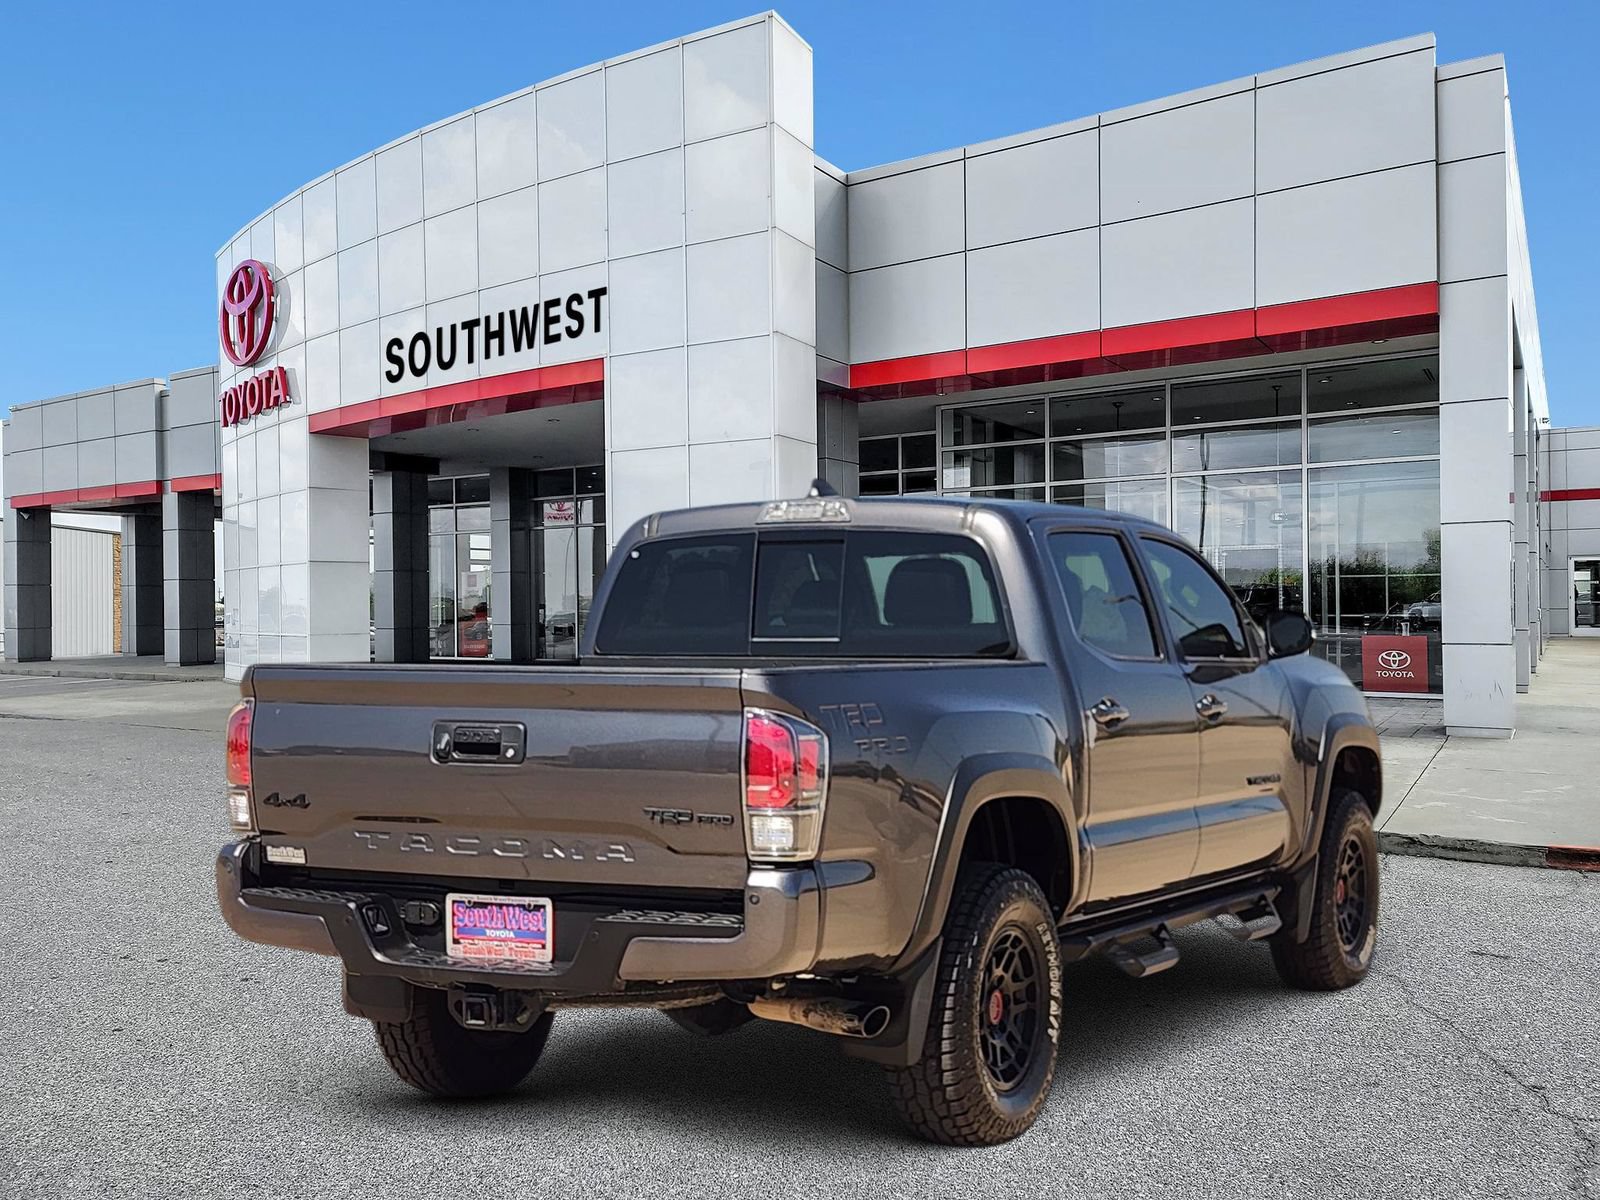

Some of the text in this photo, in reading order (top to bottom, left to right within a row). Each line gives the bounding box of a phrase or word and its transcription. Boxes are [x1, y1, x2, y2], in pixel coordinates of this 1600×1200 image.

[385, 286, 608, 384] SOUTHWEST
[218, 366, 291, 427] TOYOTA
[1375, 670, 1414, 678] TOYOTA
[819, 703, 884, 735] TRD
[642, 805, 734, 826] TRD PRO
[354, 831, 635, 863] TACOMA
[485, 929, 515, 938] TOYOTA
